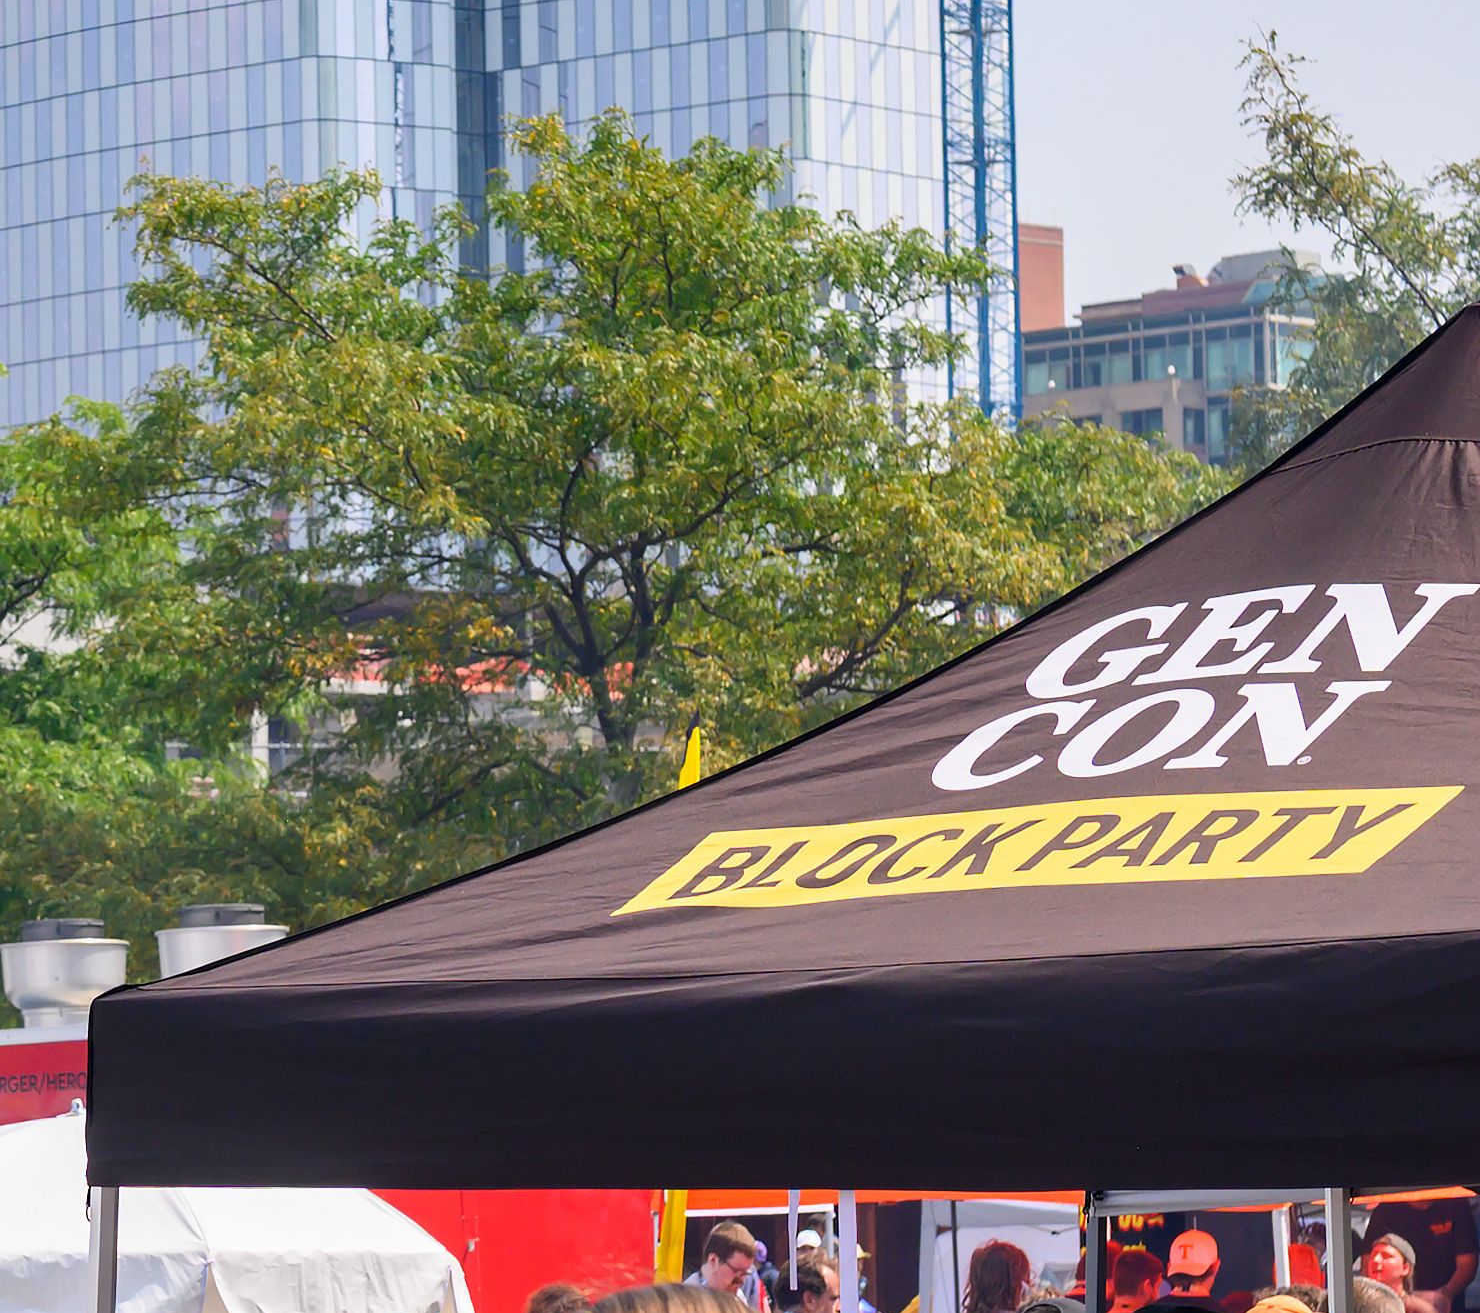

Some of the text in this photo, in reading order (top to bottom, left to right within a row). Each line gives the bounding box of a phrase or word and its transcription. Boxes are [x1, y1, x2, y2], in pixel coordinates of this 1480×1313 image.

[931, 680, 1392, 792] CON
[666, 803, 1416, 901] BLOCK PARTY
[1179, 1244, 1193, 1259] T
